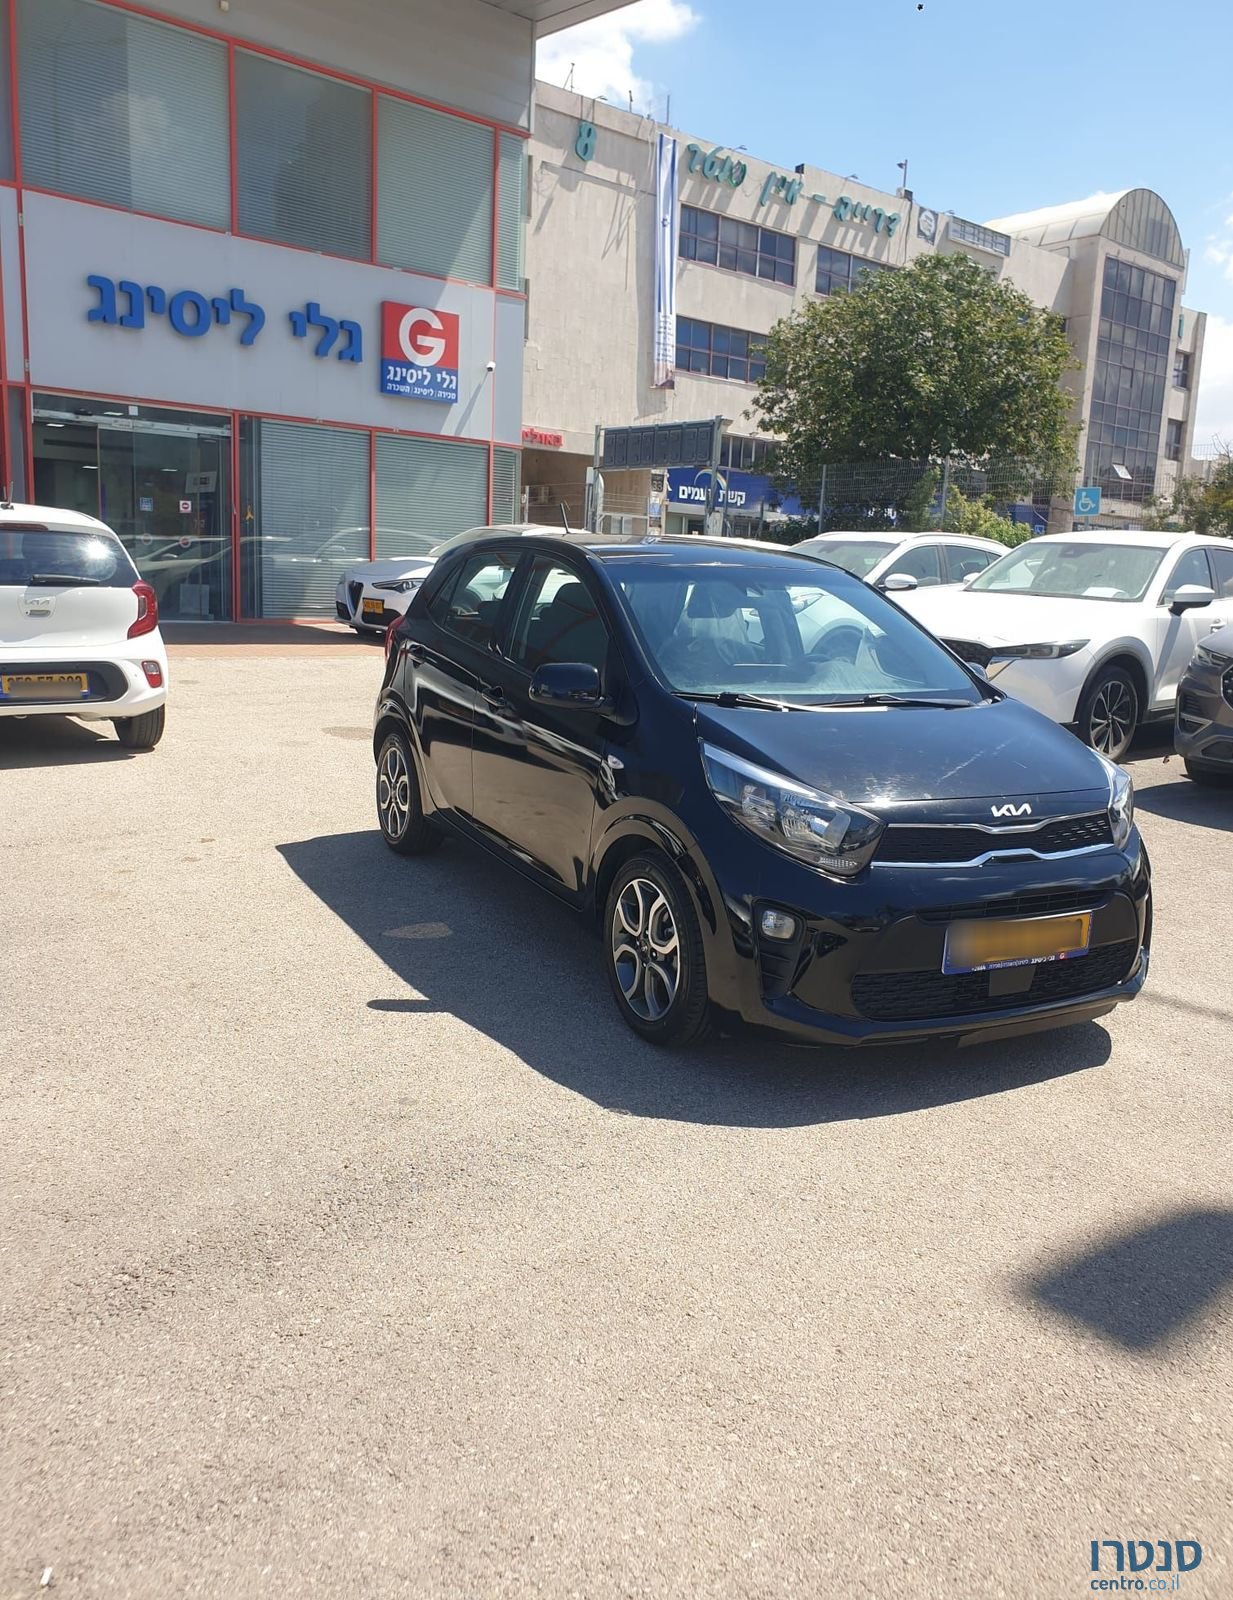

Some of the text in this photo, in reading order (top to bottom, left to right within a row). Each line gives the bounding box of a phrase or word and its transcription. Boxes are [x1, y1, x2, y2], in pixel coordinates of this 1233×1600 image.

[574, 121, 598, 162] 8
[87, 274, 363, 363] גלי ליסינג
[399, 307, 446, 367] G
[386, 366, 457, 389] גלי ליסינג
[678, 485, 712, 502] עמים
[990, 802, 1032, 817] KIA
